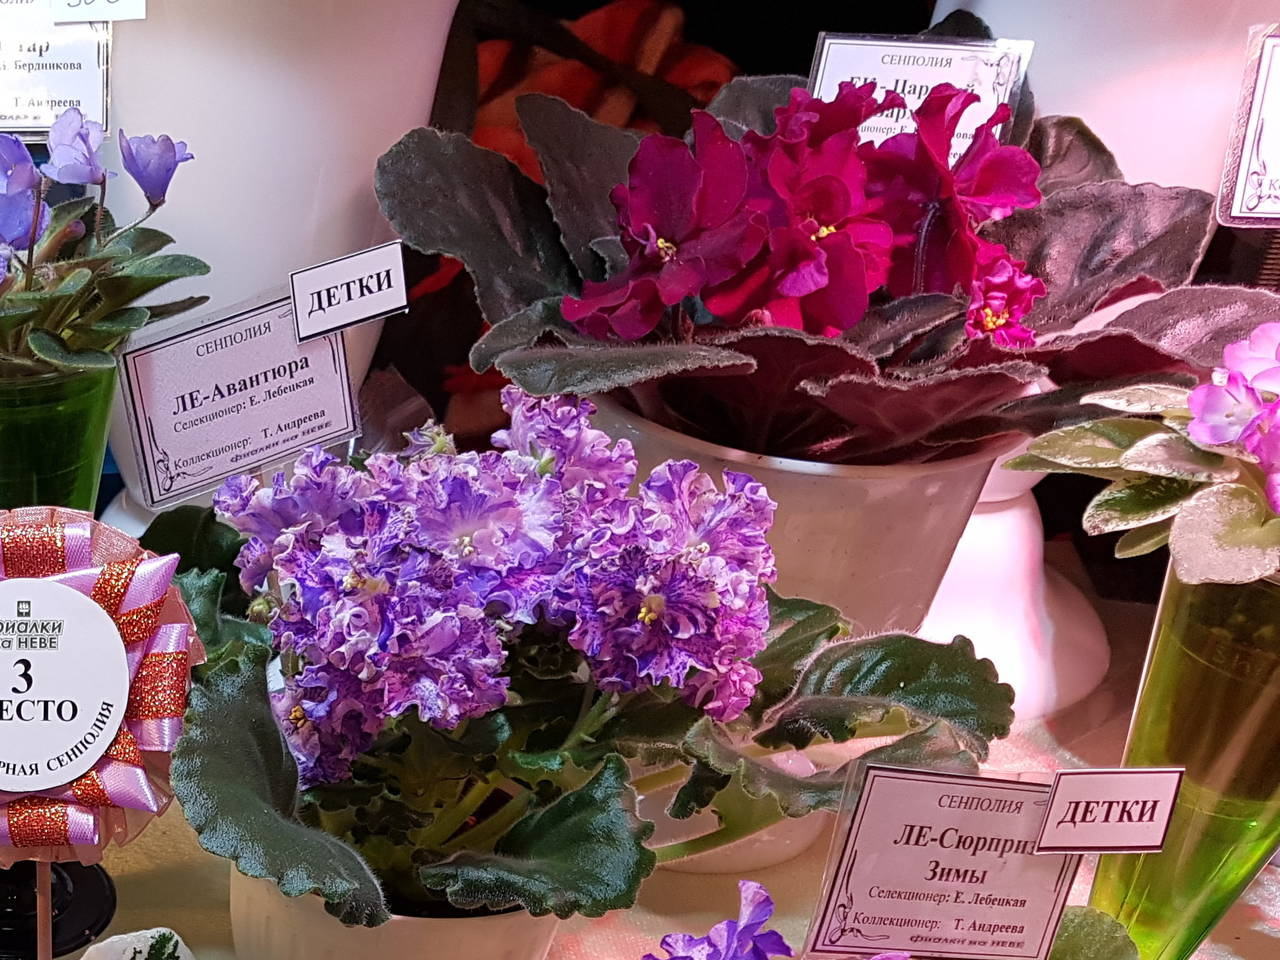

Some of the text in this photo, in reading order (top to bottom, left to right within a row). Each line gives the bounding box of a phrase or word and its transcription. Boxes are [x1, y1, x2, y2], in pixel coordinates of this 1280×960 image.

[881, 54, 953, 68] СЕНПОЛИЯ
[308, 268, 394, 318] ДЕТКИ
[196, 321, 272, 357] СЕНПОЛИЯ
[172, 356, 310, 416] ЛЕ-Авантюра
[173, 375, 315, 434] Селекционер: Е. Лебецкая
[173, 408, 326, 471] Коллекционер: Т. Андреева
[18, 637, 57, 649] НЕВЕ
[11, 658, 34, 694] 3
[46, 701, 114, 772] СЕНПОЛИЯ
[937, 794, 1024, 815] СЕНПОЛИЯ
[1056, 800, 1160, 828] ДЕТКИ
[924, 860, 987, 884] Зимы
[868, 886, 1026, 908] Селекционер: Е. Лебецкая
[852, 911, 1025, 935] Коллекционер: Т. Андреева
